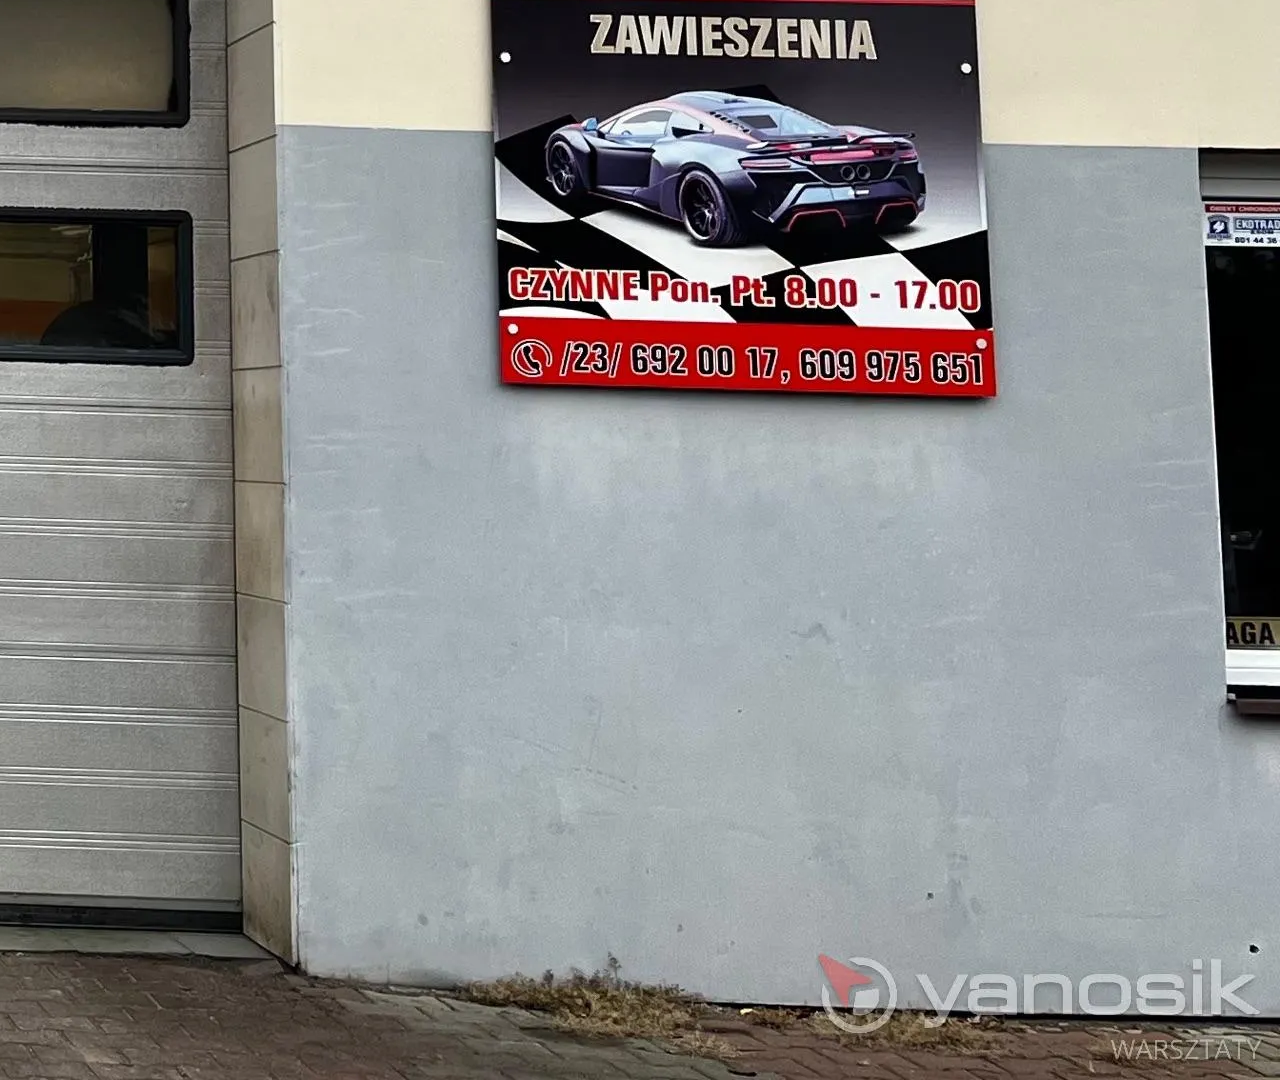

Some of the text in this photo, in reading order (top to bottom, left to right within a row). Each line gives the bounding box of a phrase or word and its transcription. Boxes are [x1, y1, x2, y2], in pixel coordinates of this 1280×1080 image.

[589, 13, 877, 60] ZAWIESZENIA
[508, 267, 640, 302] CZYNNE
[648, 271, 721, 304] Pon.
[730, 274, 776, 307] Pt.
[784, 274, 858, 309] 8.00
[894, 278, 981, 313] 17.00
[559, 341, 984, 386] /23/ 692 00 17, 609 975 651
